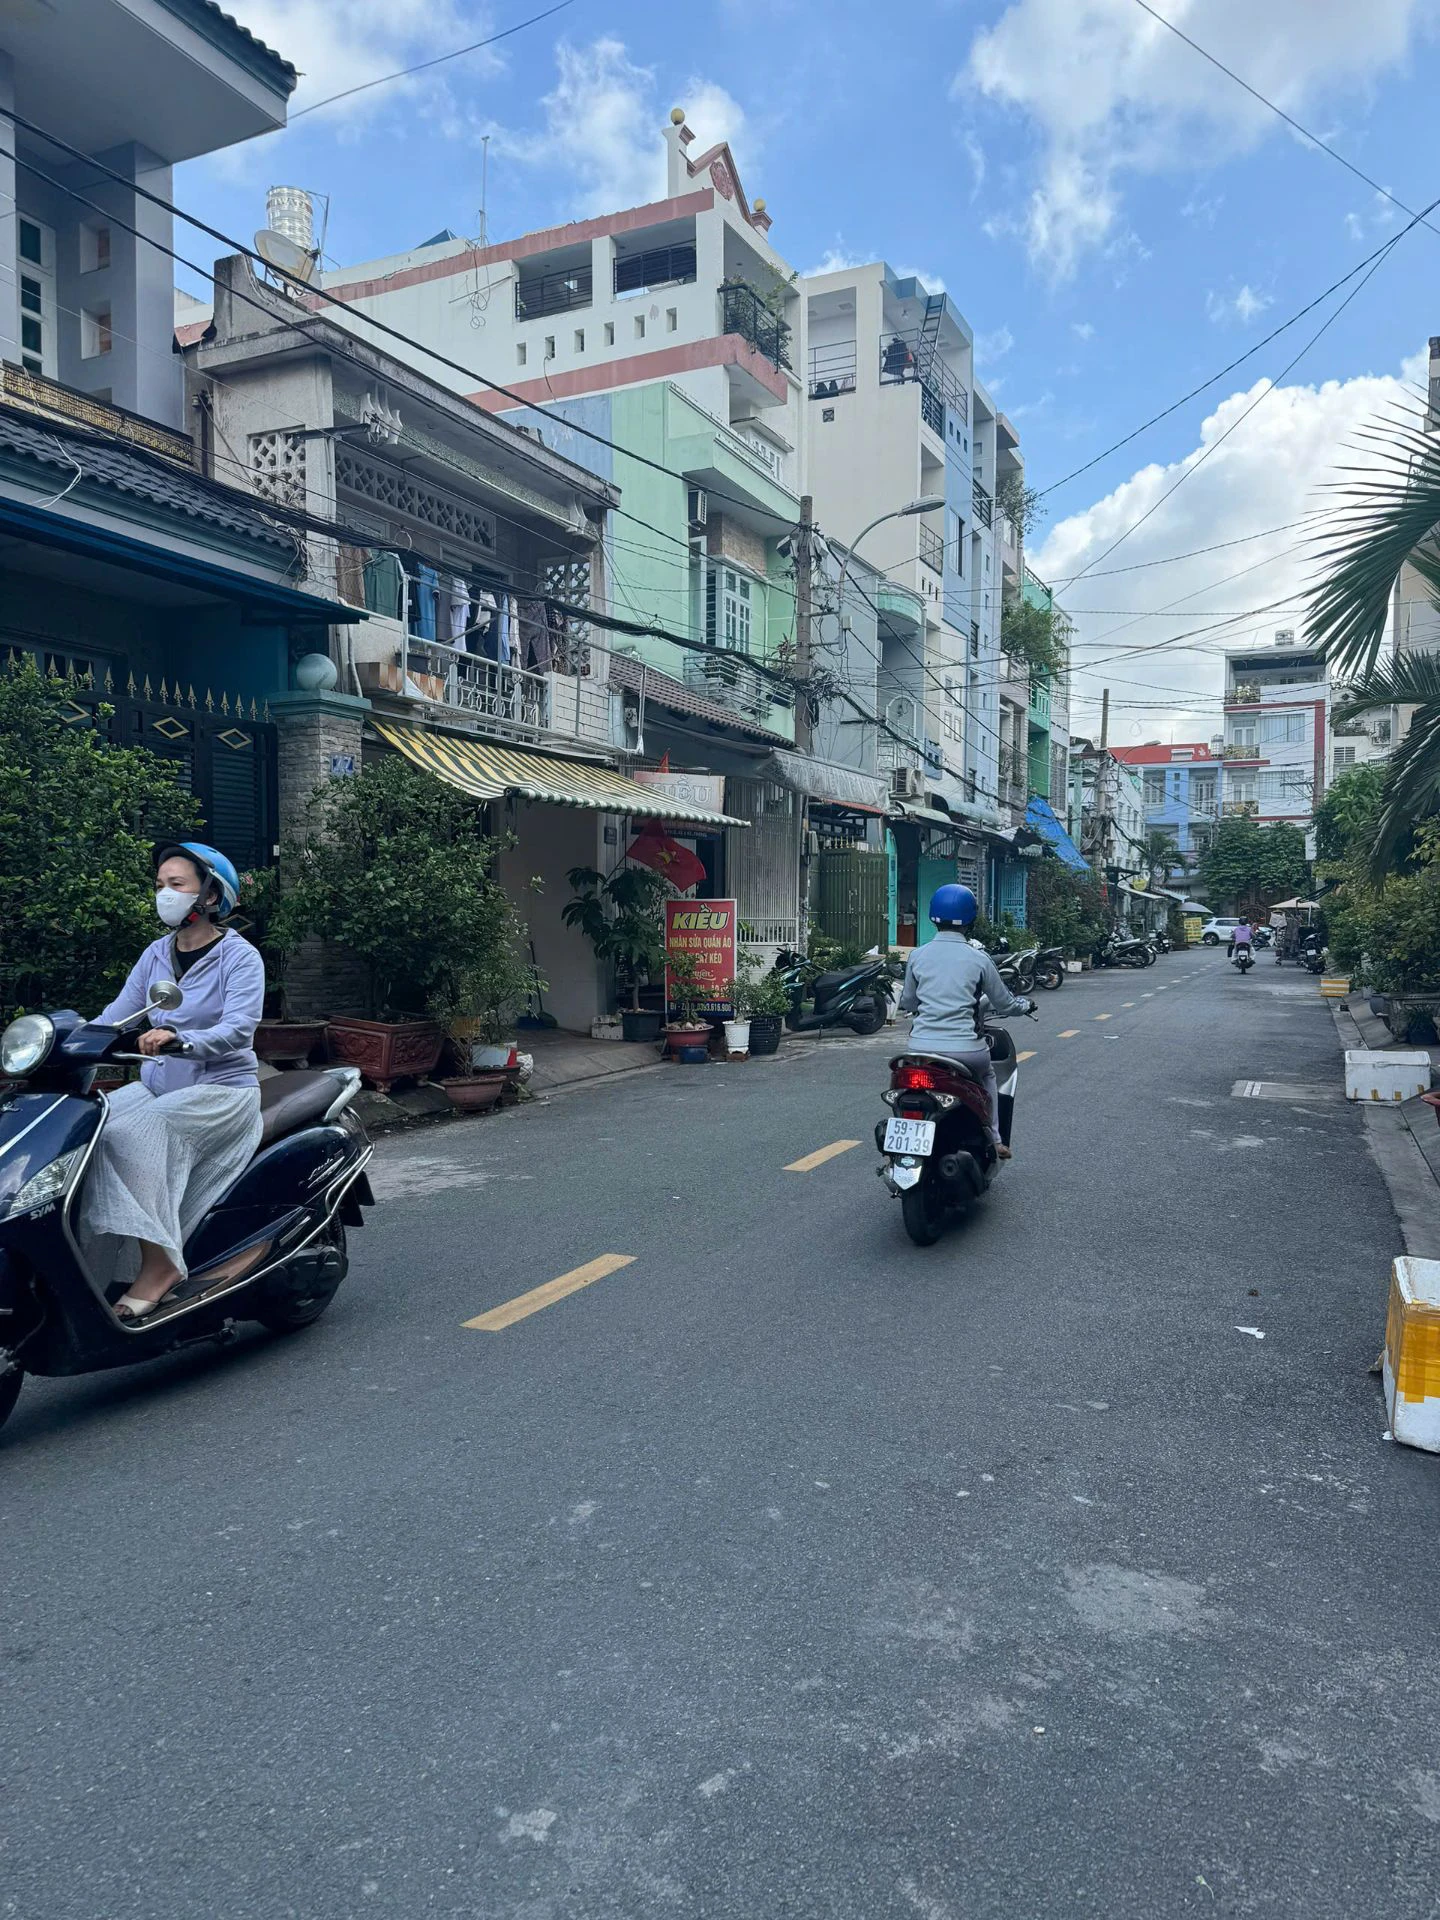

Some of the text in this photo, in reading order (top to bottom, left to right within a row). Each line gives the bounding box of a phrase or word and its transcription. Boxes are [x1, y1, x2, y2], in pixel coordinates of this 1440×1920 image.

[671, 903, 729, 930] KIỀU
[894, 1120, 927, 1137] 59-T1
[887, 1135, 930, 1153] 201.39
[30, 1202, 56, 1221] SYM
